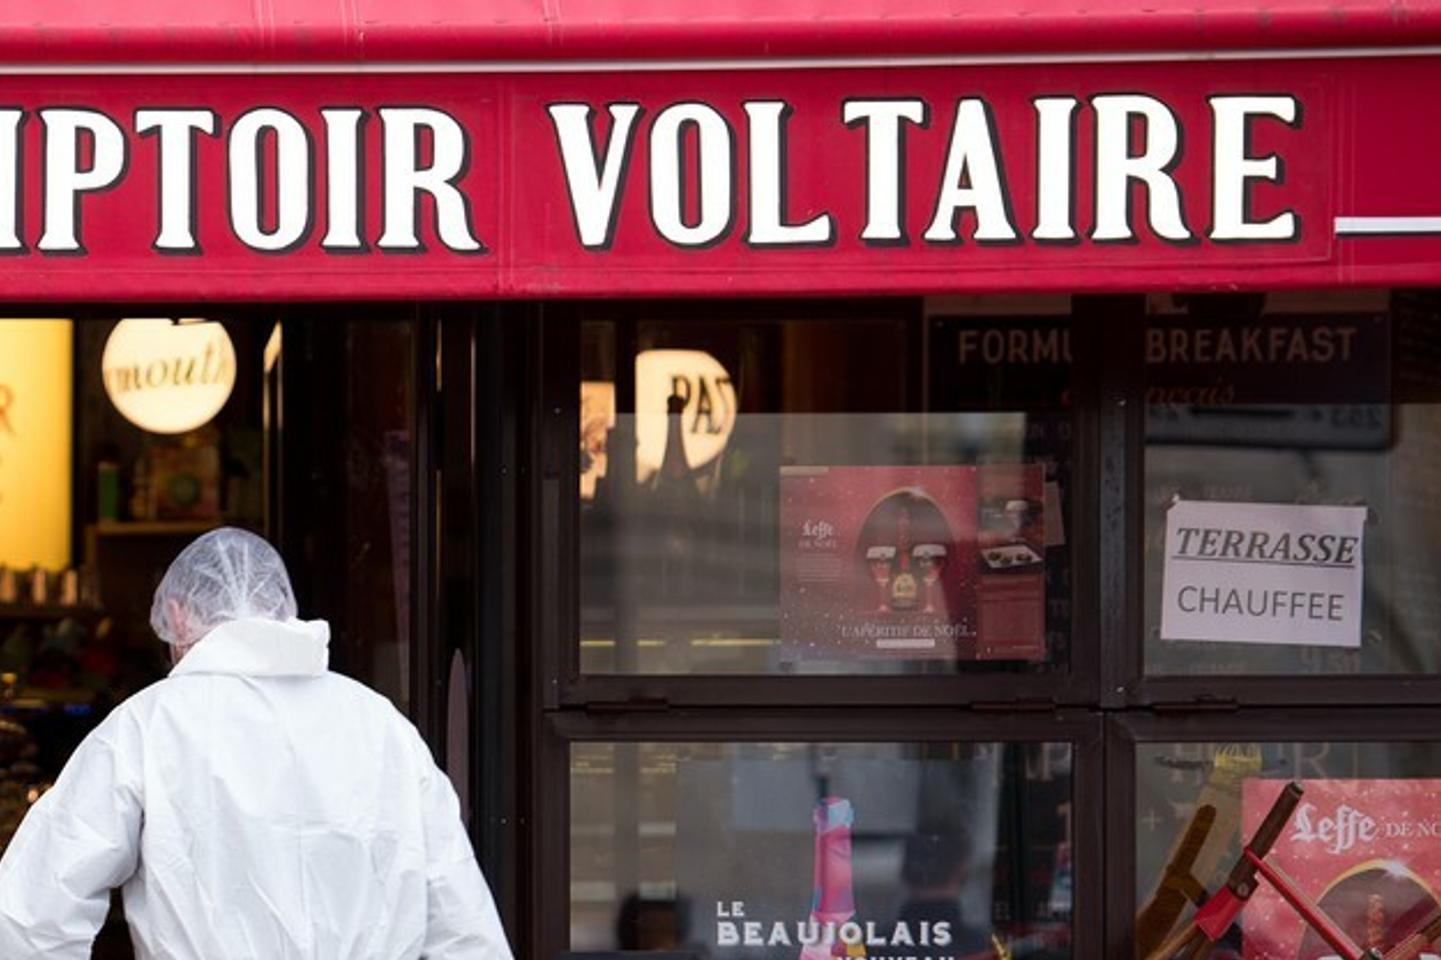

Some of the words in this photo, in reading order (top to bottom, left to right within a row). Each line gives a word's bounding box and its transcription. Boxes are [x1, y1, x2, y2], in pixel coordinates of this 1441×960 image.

[546, 94, 1303, 250] VOLTAIRE
[1145, 325, 1357, 364] BREAKFAST
[1175, 527, 1359, 566] TERRASSE
[1177, 585, 1345, 621] CHAUFFEE
[1290, 803, 1379, 854] Leffe
[716, 901, 745, 917] LE
[716, 921, 954, 946] BEAUJOLAIS
